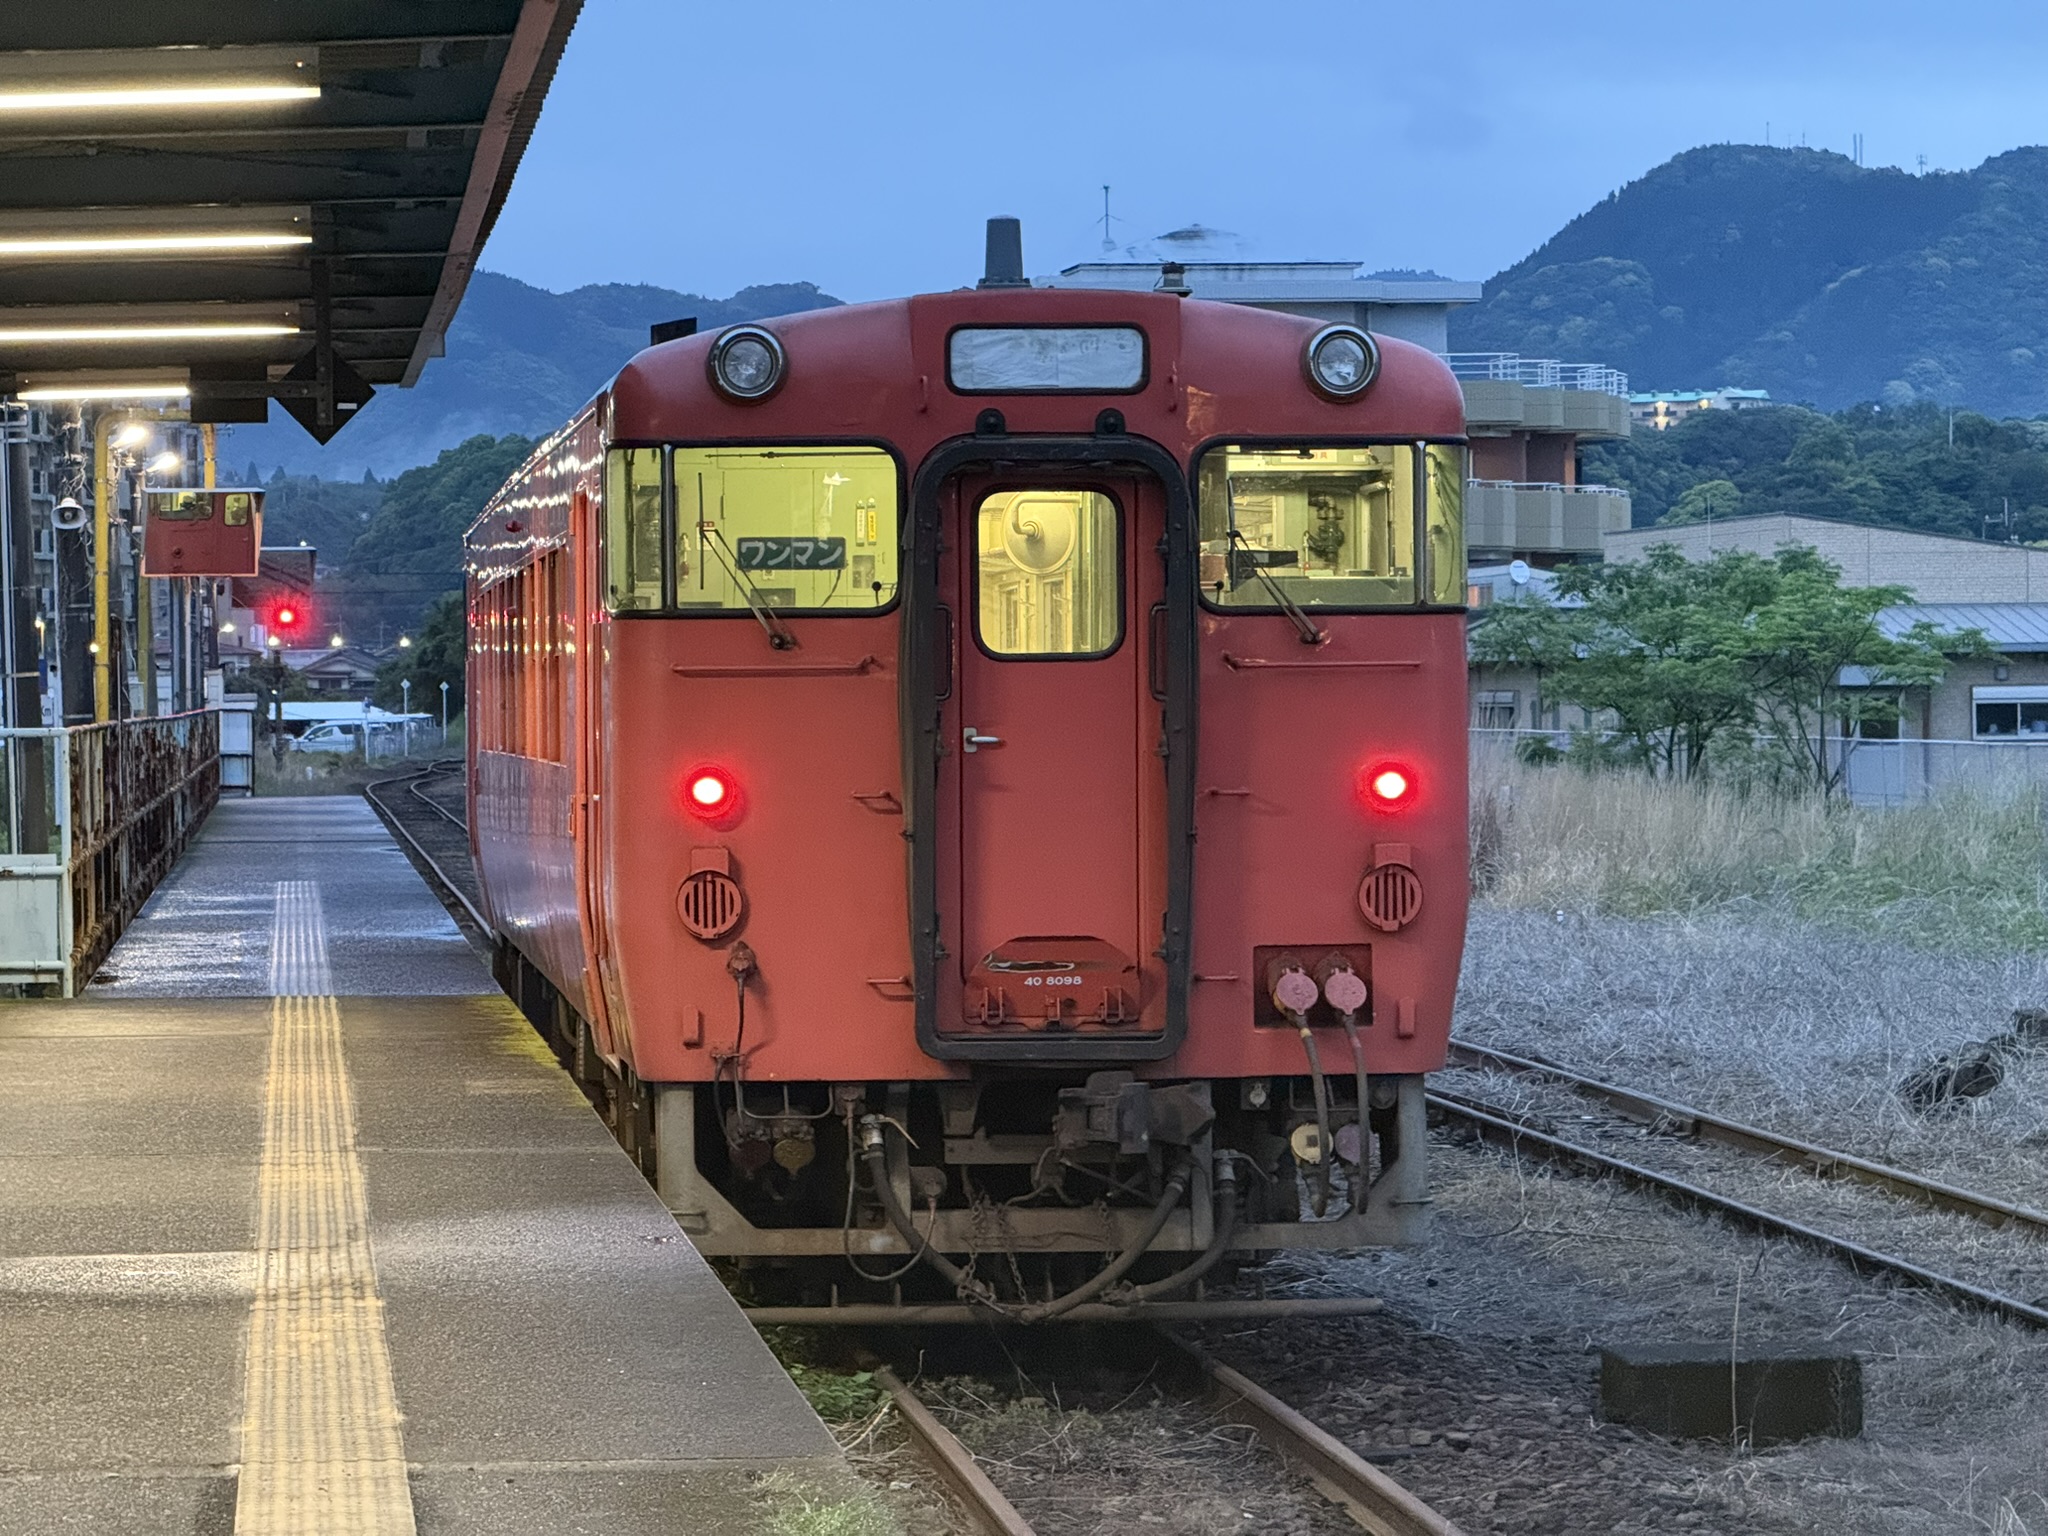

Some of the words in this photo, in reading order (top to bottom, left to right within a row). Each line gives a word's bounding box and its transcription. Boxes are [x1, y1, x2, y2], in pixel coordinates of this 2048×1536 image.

[741, 541, 842, 566] ワンマン
[1024, 976, 1042, 986] 40
[1046, 976, 1082, 986] 8098
